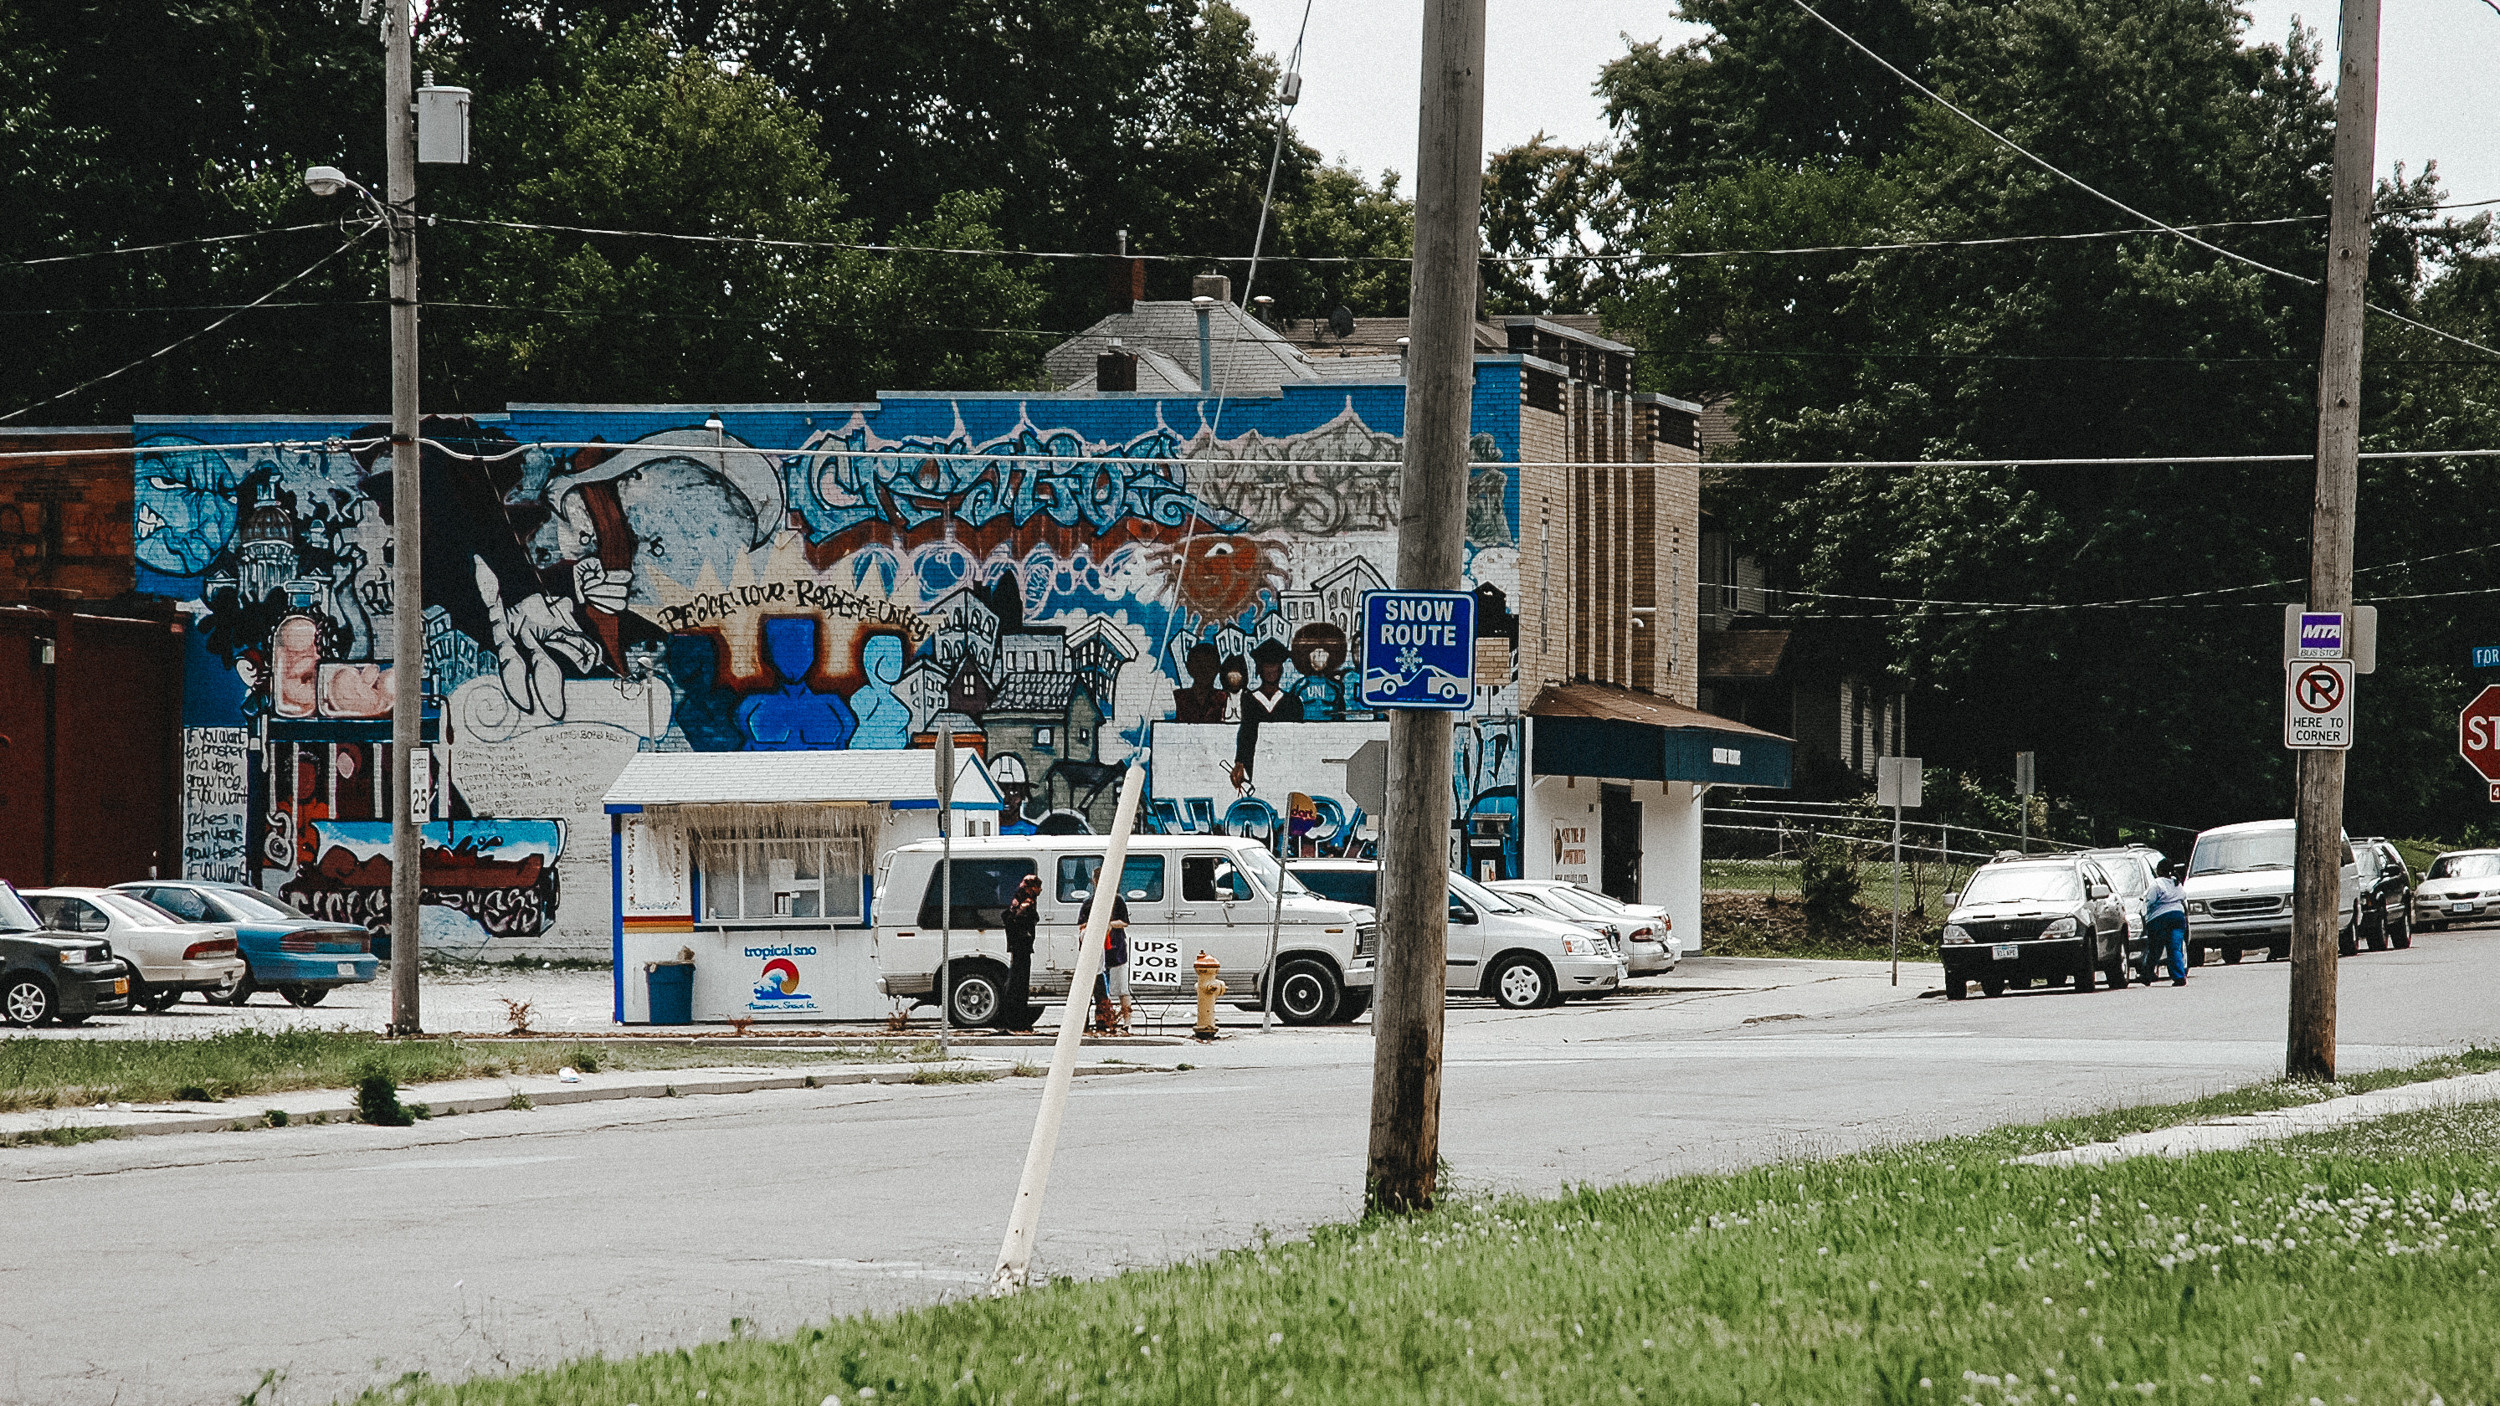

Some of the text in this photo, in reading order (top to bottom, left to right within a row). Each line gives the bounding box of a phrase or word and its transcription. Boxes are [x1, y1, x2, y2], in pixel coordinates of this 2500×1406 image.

[1385, 600, 1454, 622] SNOW
[1381, 624, 1457, 646] ROUTE
[2302, 624, 2341, 639] MTA
[2300, 649, 2342, 657] BUS STOP
[2476, 649, 2500, 667] FOR
[1307, 684, 1325, 699] UNI
[2293, 717, 2344, 729] HERE TO
[2296, 730, 2341, 742] CORNER
[185, 744, 247, 760] to prosper
[211, 758, 239, 778] year
[413, 788, 427, 814] 25
[744, 943, 817, 960] tropical sno
[1134, 941, 1178, 953] UPS
[1134, 956, 1178, 968] JOB
[1132, 971, 1177, 983] FAIR
